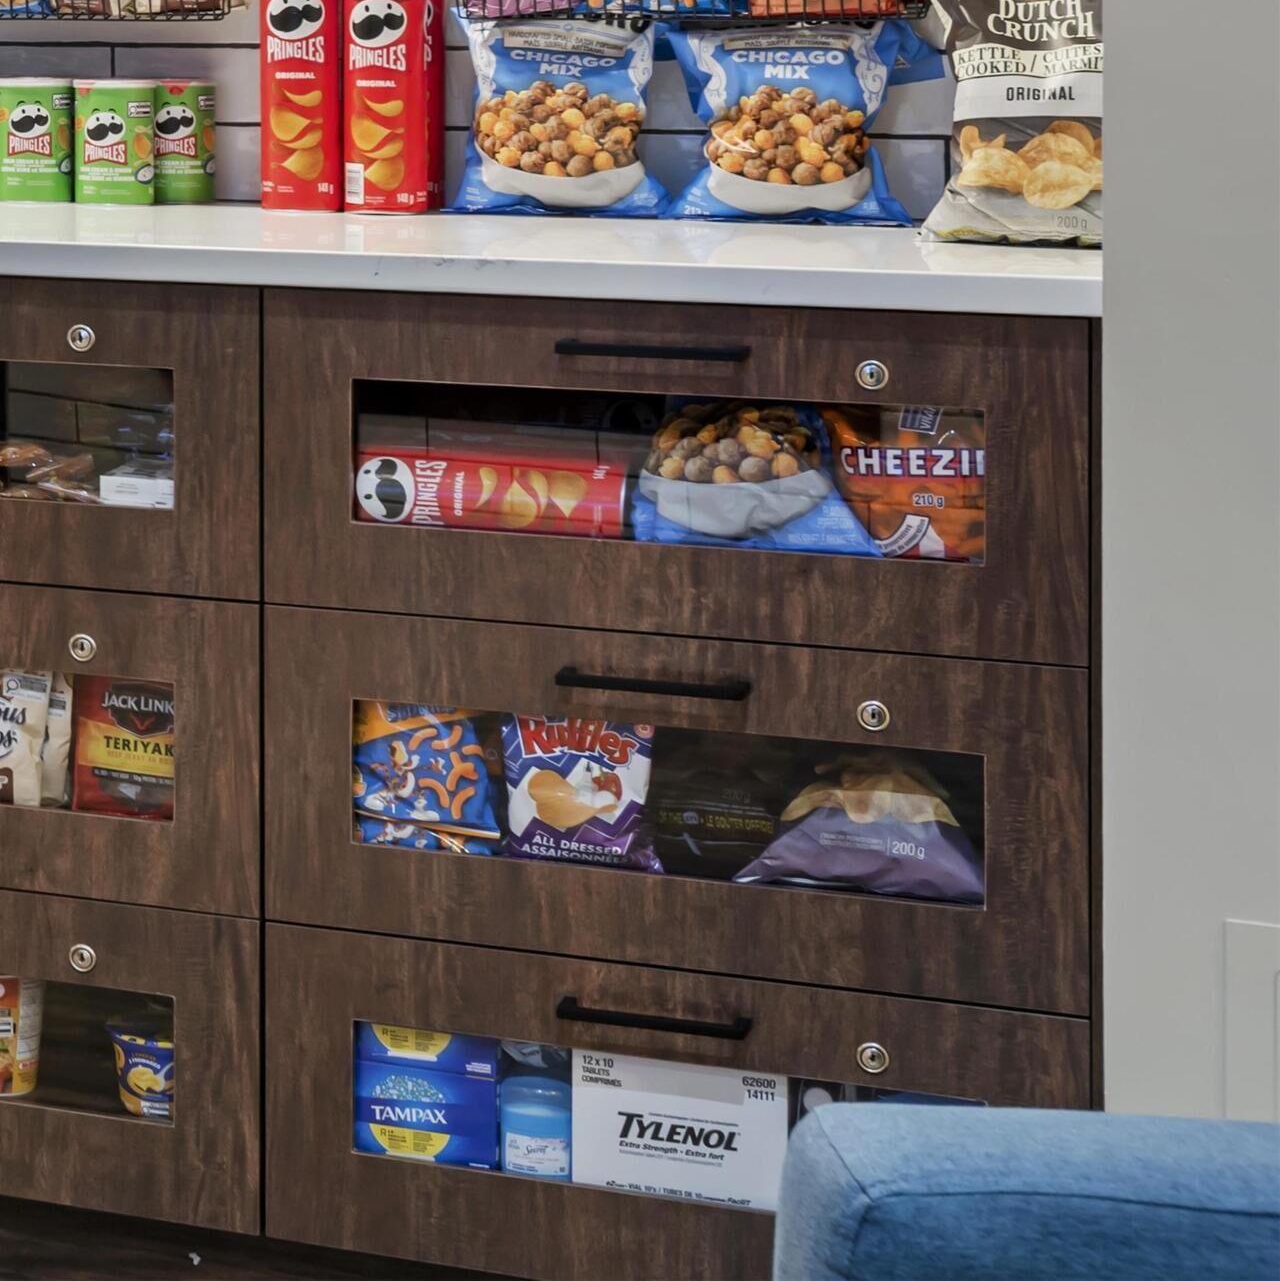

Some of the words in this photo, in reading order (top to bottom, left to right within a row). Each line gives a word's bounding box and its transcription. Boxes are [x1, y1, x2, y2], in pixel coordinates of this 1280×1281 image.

[987, 11, 1097, 42] CRUNCH
[267, 35, 324, 63] PRINGLES
[349, 44, 406, 71] PRINGLES
[510, 50, 617, 67] CHICAGO
[732, 51, 845, 65] CHICAGO
[958, 46, 1022, 64] KETTLE
[540, 63, 583, 77] MIX
[764, 64, 810, 79] MIX
[956, 60, 1027, 78] COOKED
[1006, 86, 1076, 102] ORIGINAL
[9, 134, 51, 156] PRINGLES
[411, 459, 448, 525] PRINGLES
[453, 470, 465, 516] ORIGINAL
[913, 494, 934, 506] 210
[936, 496, 945, 509] g
[102, 692, 139, 711] JACK
[515, 712, 640, 767] Ruffles
[532, 834, 556, 848] ALL
[561, 837, 622, 856] DRESSED
[891, 840, 915, 857] 200
[917, 846, 926, 861] g
[582, 1054, 593, 1066] 12
[603, 1058, 614, 1068] 10
[582, 1066, 610, 1077] TABLETS
[742, 1075, 776, 1089] 62600
[746, 1089, 775, 1102] 14111
[370, 1104, 448, 1125] TAMPAX
[617, 1111, 738, 1152] TYLENOL
[619, 1140, 640, 1149] Extra
[642, 1143, 678, 1155] Strength
[685, 1149, 707, 1159] Extra
[709, 1152, 725, 1161] fort
